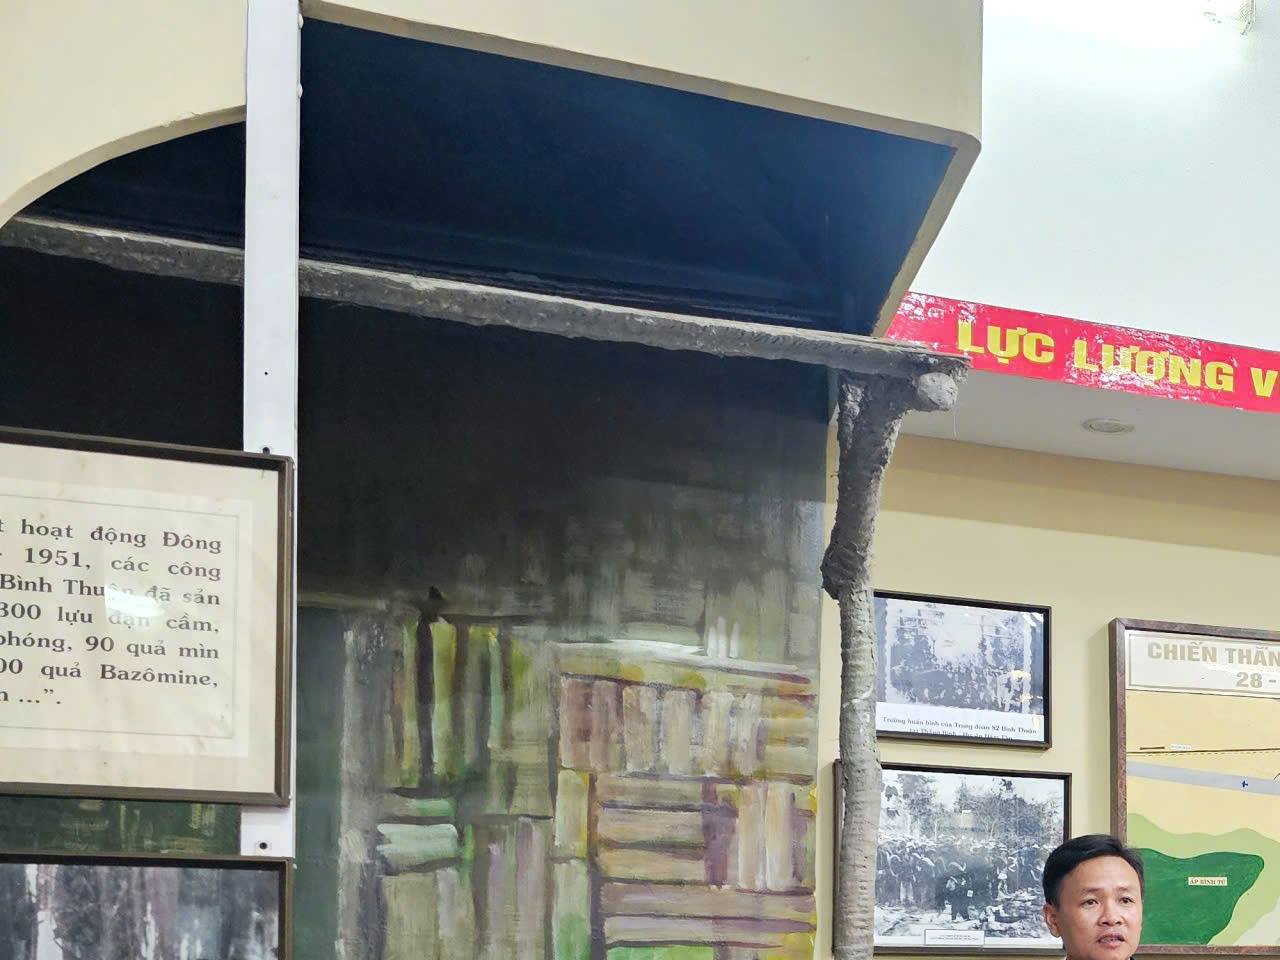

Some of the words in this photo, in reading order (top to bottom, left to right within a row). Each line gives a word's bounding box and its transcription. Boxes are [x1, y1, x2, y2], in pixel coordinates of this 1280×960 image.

[958, 319, 1054, 369] LỰC
[1075, 337, 1234, 396] LƯỢNG
[21, 518, 74, 541] hoạt
[90, 526, 147, 548] động
[163, 531, 222, 554] Đông
[25, 547, 91, 570] 1951,
[111, 556, 150, 572] các
[168, 562, 222, 582] công
[0, 573, 52, 593] Bình
[183, 588, 220, 606] sản
[57, 606, 94, 626] lựu
[166, 612, 220, 634] cầm,
[85, 636, 115, 652] 90
[127, 639, 167, 657] quả
[179, 643, 220, 660] mìn
[1147, 641, 1217, 663] CHIẾN
[41, 662, 82, 679] quả
[100, 663, 219, 688] Bazômine,
[1236, 671, 1263, 688] 28
